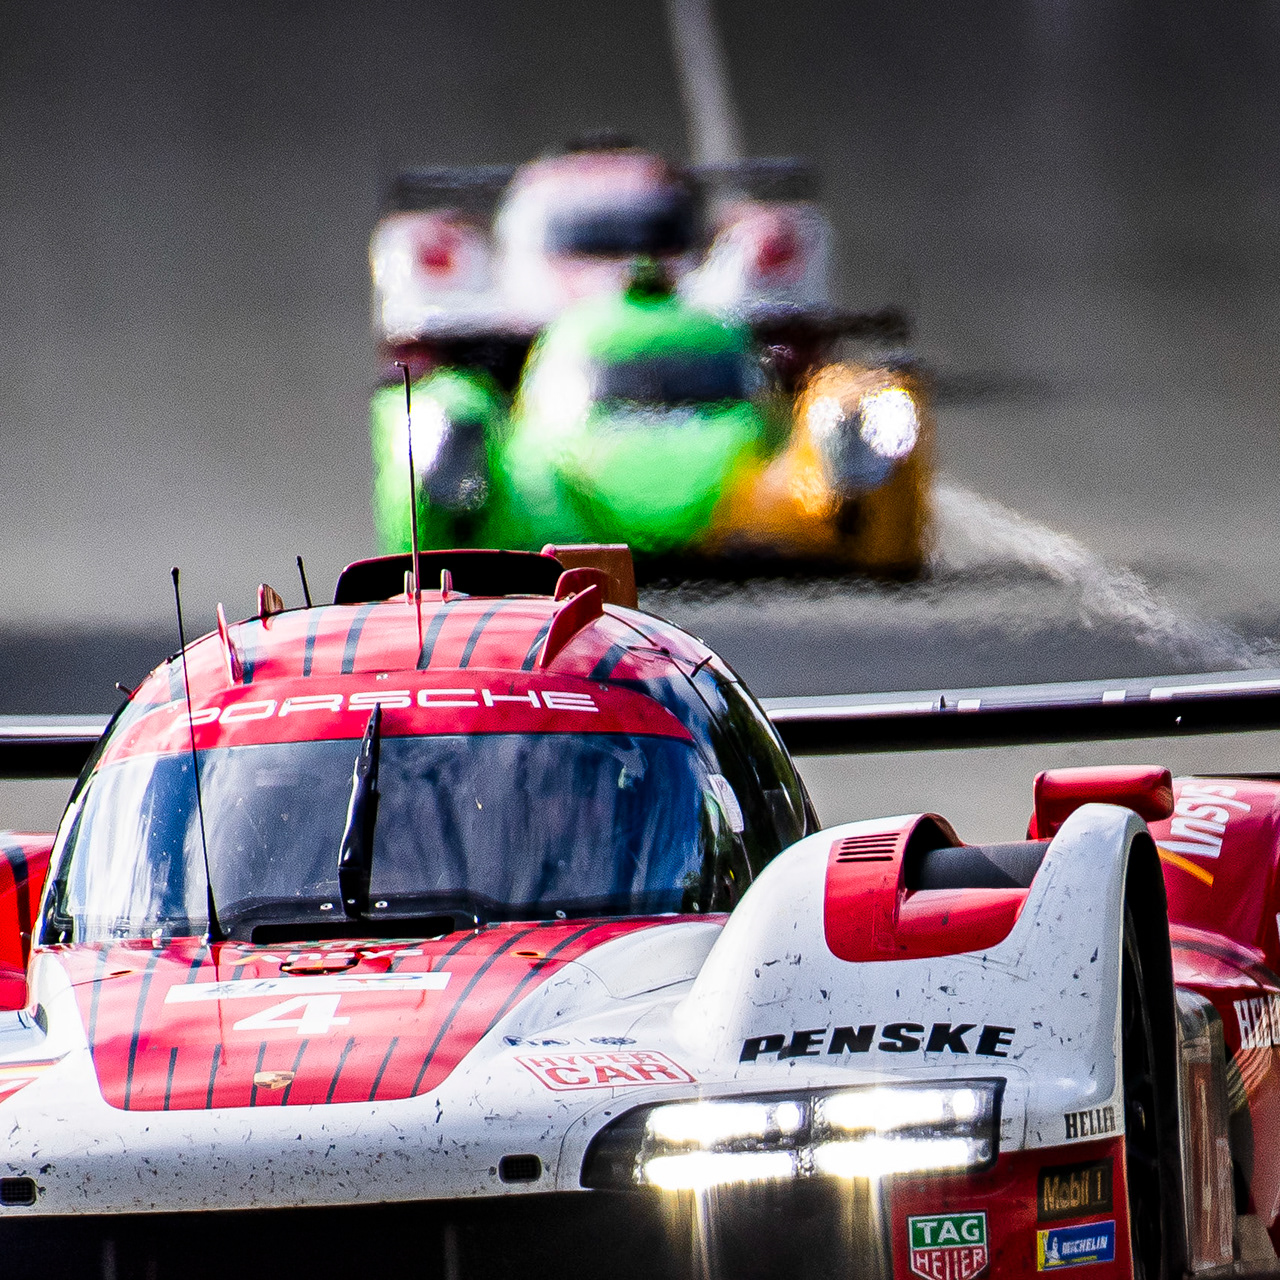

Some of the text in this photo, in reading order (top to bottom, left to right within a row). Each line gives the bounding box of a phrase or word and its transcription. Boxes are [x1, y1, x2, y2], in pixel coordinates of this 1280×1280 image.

[171, 688, 599, 729] PORSCHE
[232, 993, 351, 1035] 4
[528, 1051, 661, 1068] HYPER
[739, 1022, 1016, 1062] PENSKE
[545, 1063, 682, 1085] CAR
[1064, 1106, 1116, 1139] HELLER
[1043, 1169, 1090, 1211] Mobil
[917, 1219, 980, 1244] TAG
